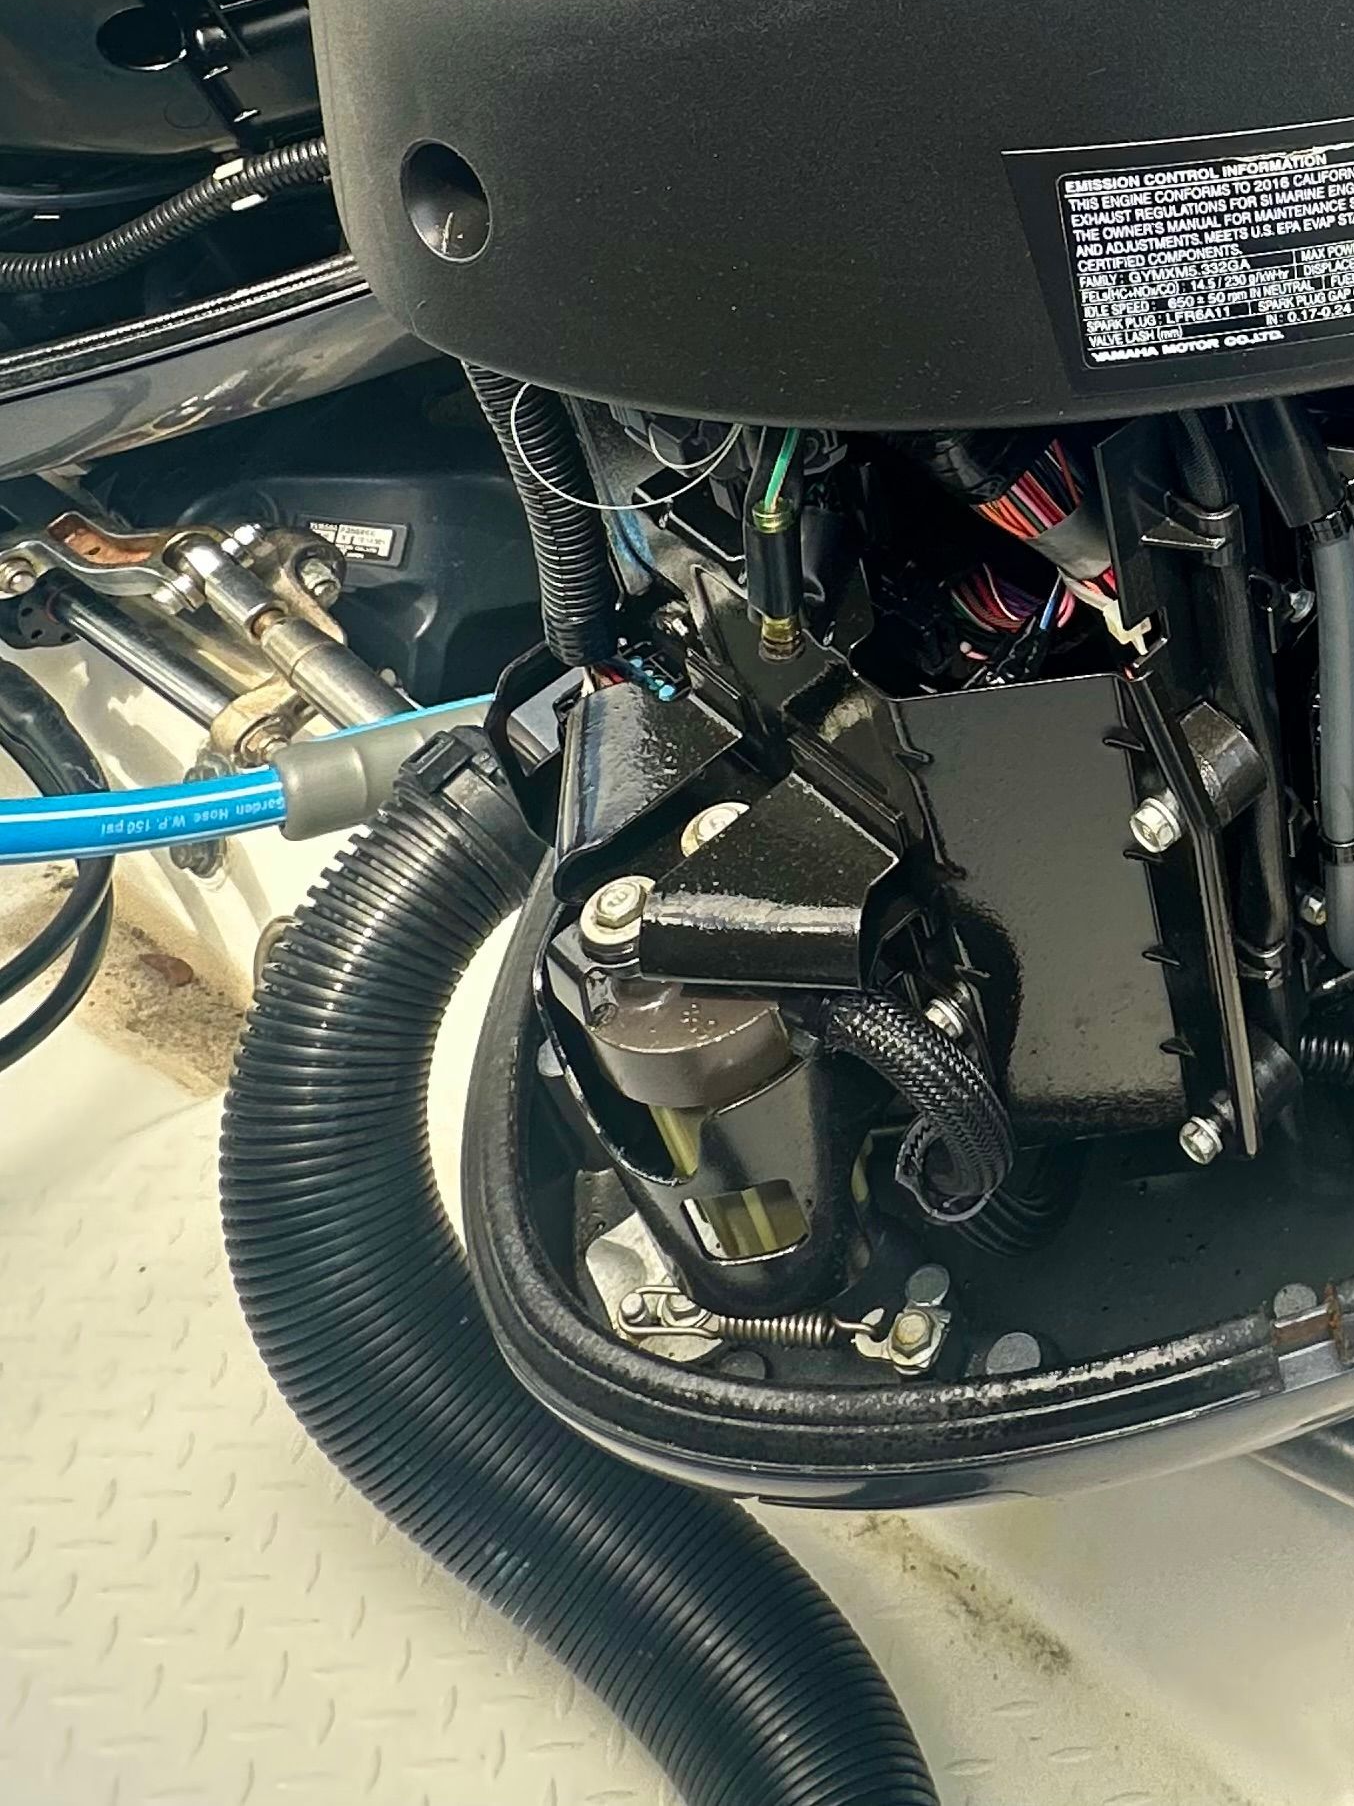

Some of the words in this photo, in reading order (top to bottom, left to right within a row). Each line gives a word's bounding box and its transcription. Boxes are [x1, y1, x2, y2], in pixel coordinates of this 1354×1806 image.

[1065, 175, 1140, 193] EMISSION
[1144, 167, 1219, 186] CONTROL
[1222, 153, 1327, 178] INFORMATION
[1069, 197, 1099, 211] THIS
[1102, 192, 1152, 209] ENGINE
[1155, 183, 1231, 203] CONFORMS
[1232, 181, 1251, 193] TO
[1254, 176, 1289, 192] 2016
[1071, 210, 1131, 228] EXHAUST
[1135, 198, 1227, 221] REGULATIONS
[1230, 195, 1257, 209] FOR
[1261, 193, 1273, 206] SI
[1276, 187, 1325, 205] MARINE
[1073, 229, 1100, 243] THE
[1103, 222, 1165, 240] OWNER'S
[1167, 216, 1221, 234] MANUAL
[1224, 211, 1252, 226] FOR
[1255, 198, 1347, 222] MAINTENANCE
[1076, 244, 1103, 258] AND
[1106, 233, 1203, 254] ADJUSTMENTS.
[1204, 227, 1248, 243] MEETS
[1251, 225, 1274, 238] U.S.
[1277, 221, 1302, 235] EPA
[1303, 216, 1336, 231] EVAP
[1078, 254, 1145, 272] CERTIFIED
[1148, 244, 1243, 265] COMPONENTS.
[1301, 248, 1326, 262] MAX
[1190, 277, 1215, 291] 14.5
[1225, 274, 1247, 287] 230
[1084, 304, 1110, 319] IDLE
[1168, 296, 1194, 309] 650
[1208, 292, 1225, 305] 50
[1250, 287, 1262, 298] IN
[1263, 280, 1315, 297] NEUTRAL
[1258, 297, 1295, 312] SPARK
[1297, 292, 1326, 308] PLUG
[1086, 318, 1124, 333] SPARK
[1166, 306, 1230, 324] LFR6A11
[1089, 331, 1123, 347] VALVE
[1125, 328, 1155, 343] LASH
[1091, 347, 1159, 362] YAMAHA
[1162, 339, 1219, 355] MOTOR
[125, 817, 151, 835] 150
[193, 807, 229, 824] Hose
